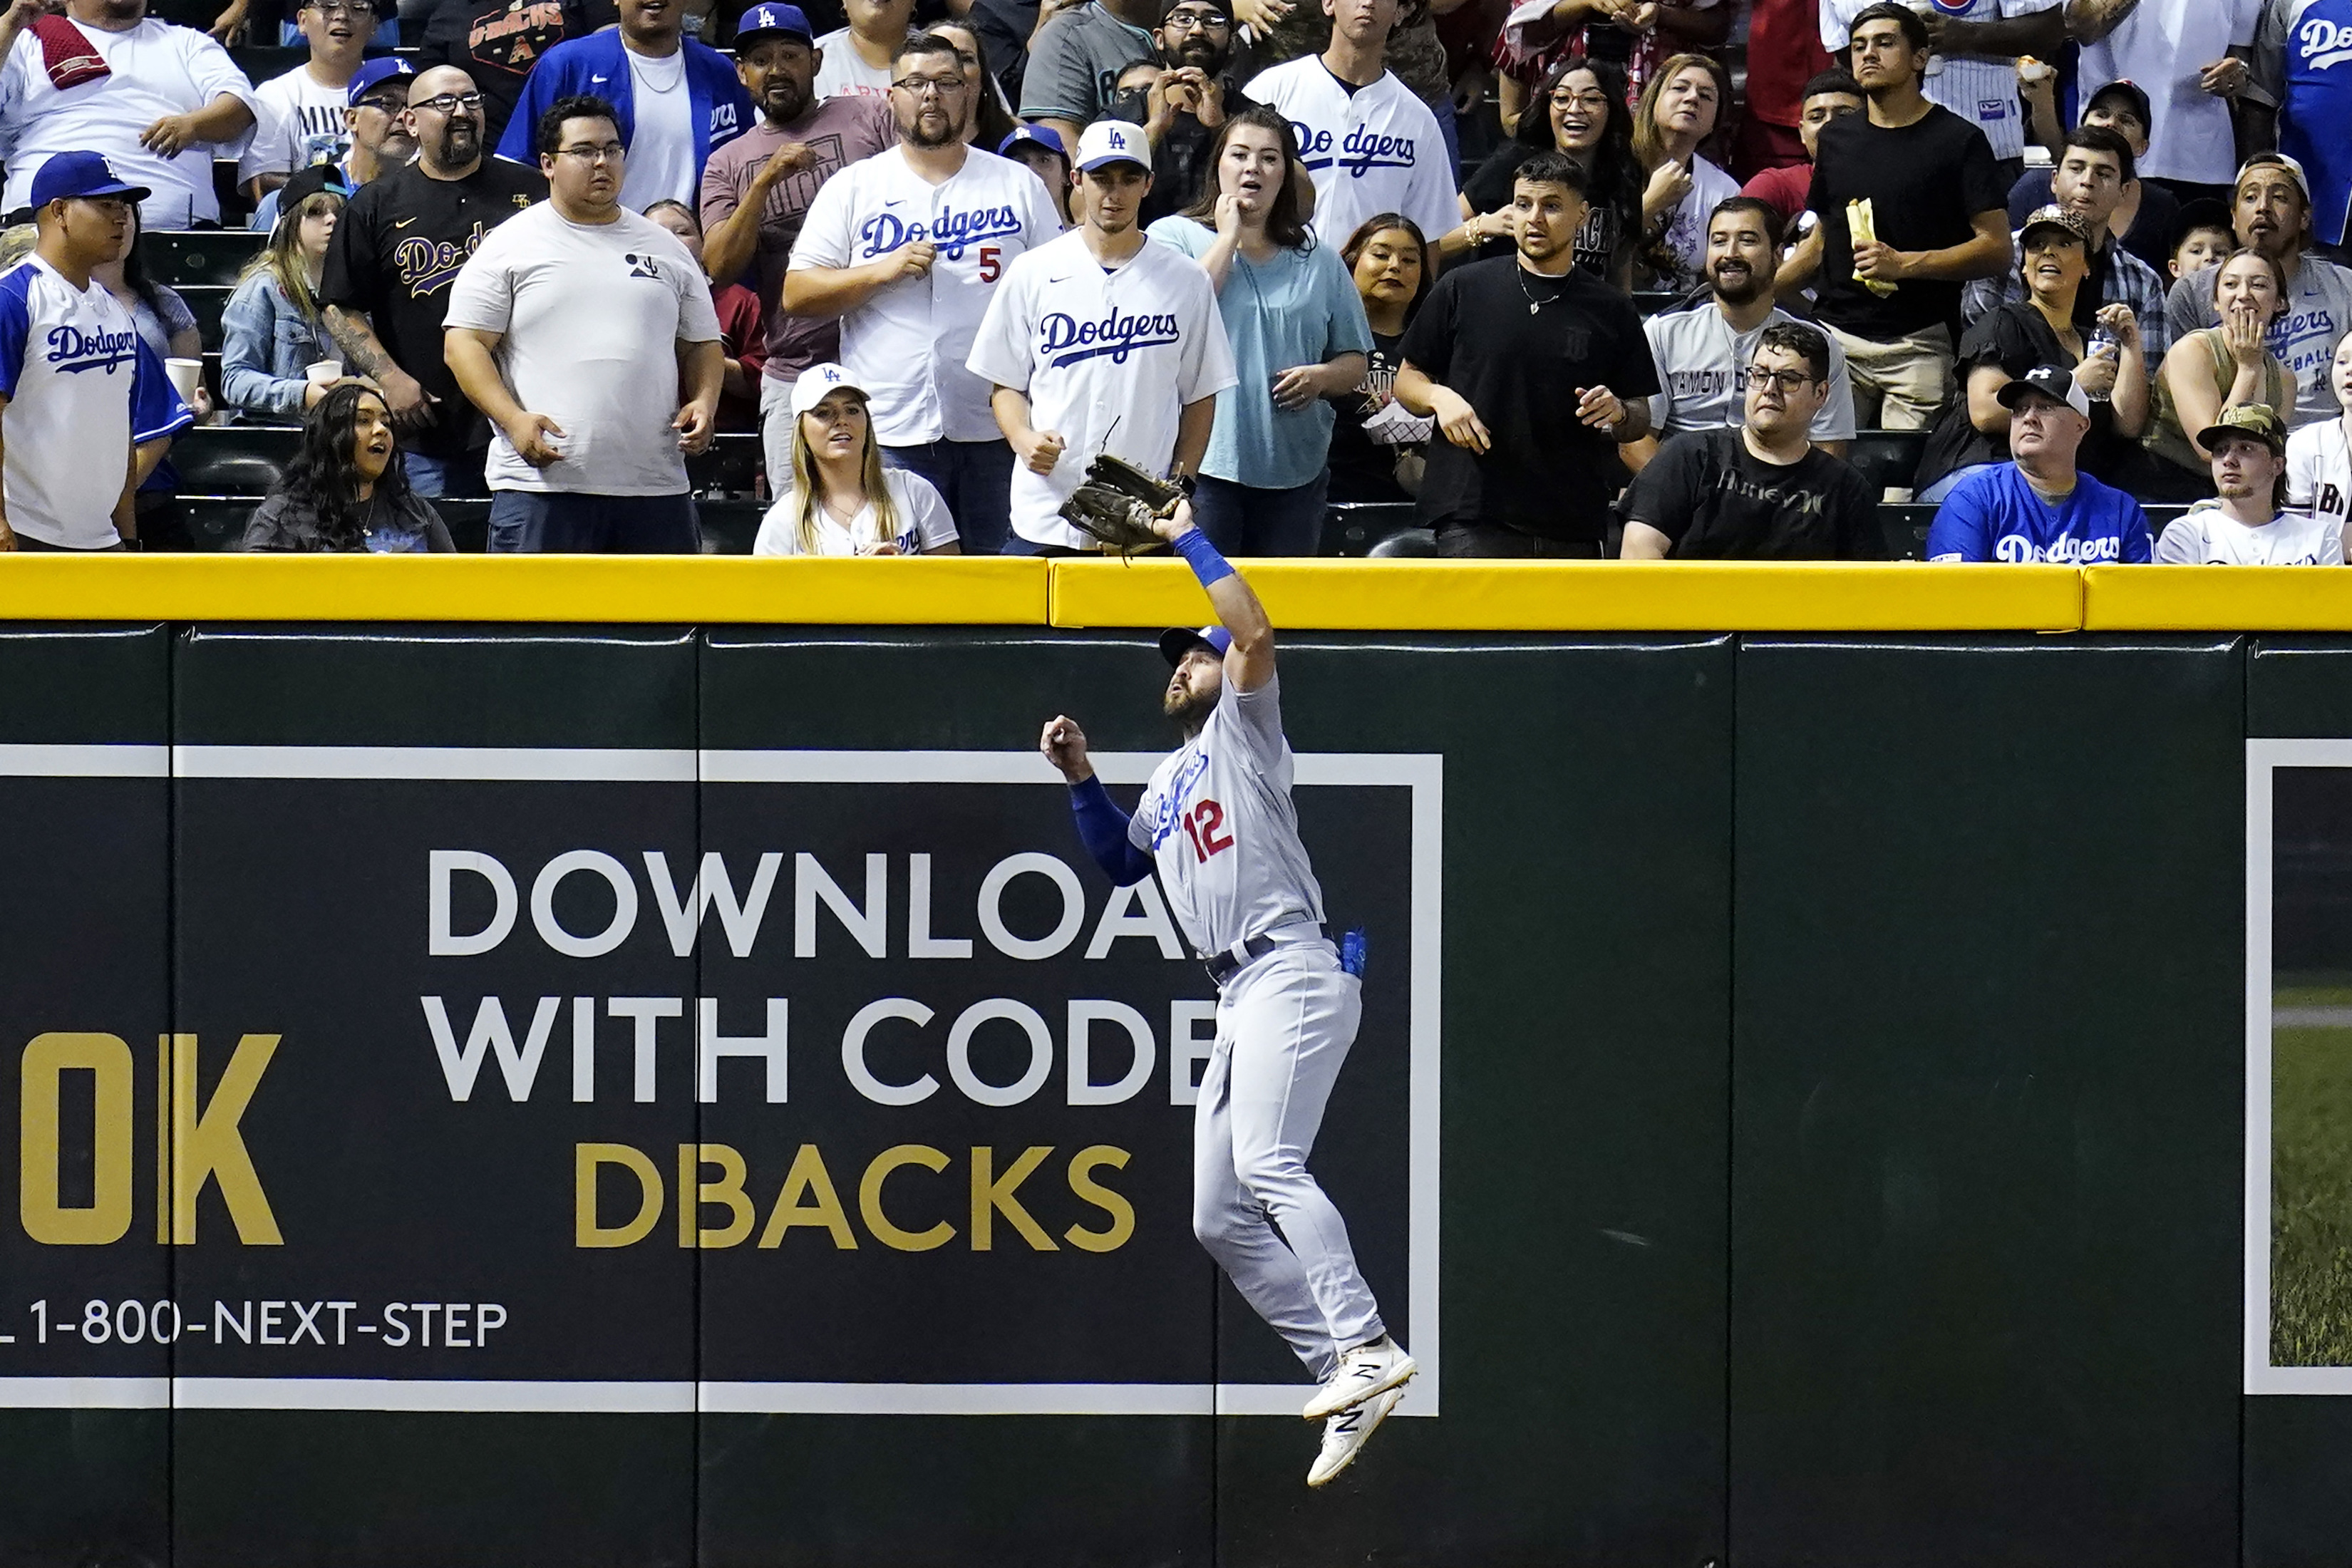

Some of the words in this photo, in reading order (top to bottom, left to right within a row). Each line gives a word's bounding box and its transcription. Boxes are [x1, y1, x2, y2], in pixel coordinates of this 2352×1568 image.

[758, 6, 776, 27] LA
[1108, 128, 1125, 149] LA
[862, 205, 1021, 261] Dodgers
[980, 248, 1001, 283] 5
[1041, 306, 1180, 368] Dodgers
[822, 367, 842, 382] LA
[1184, 799, 1234, 864] 12
[429, 850, 1207, 960] DOWNLOA
[421, 996, 788, 1103] WITH
[842, 998, 1217, 1106] CODE
[20, 1032, 284, 1245] OK
[575, 1143, 1135, 1252] DBACKS
[30, 1299, 507, 1347] 1-800-NEXT-STEP
